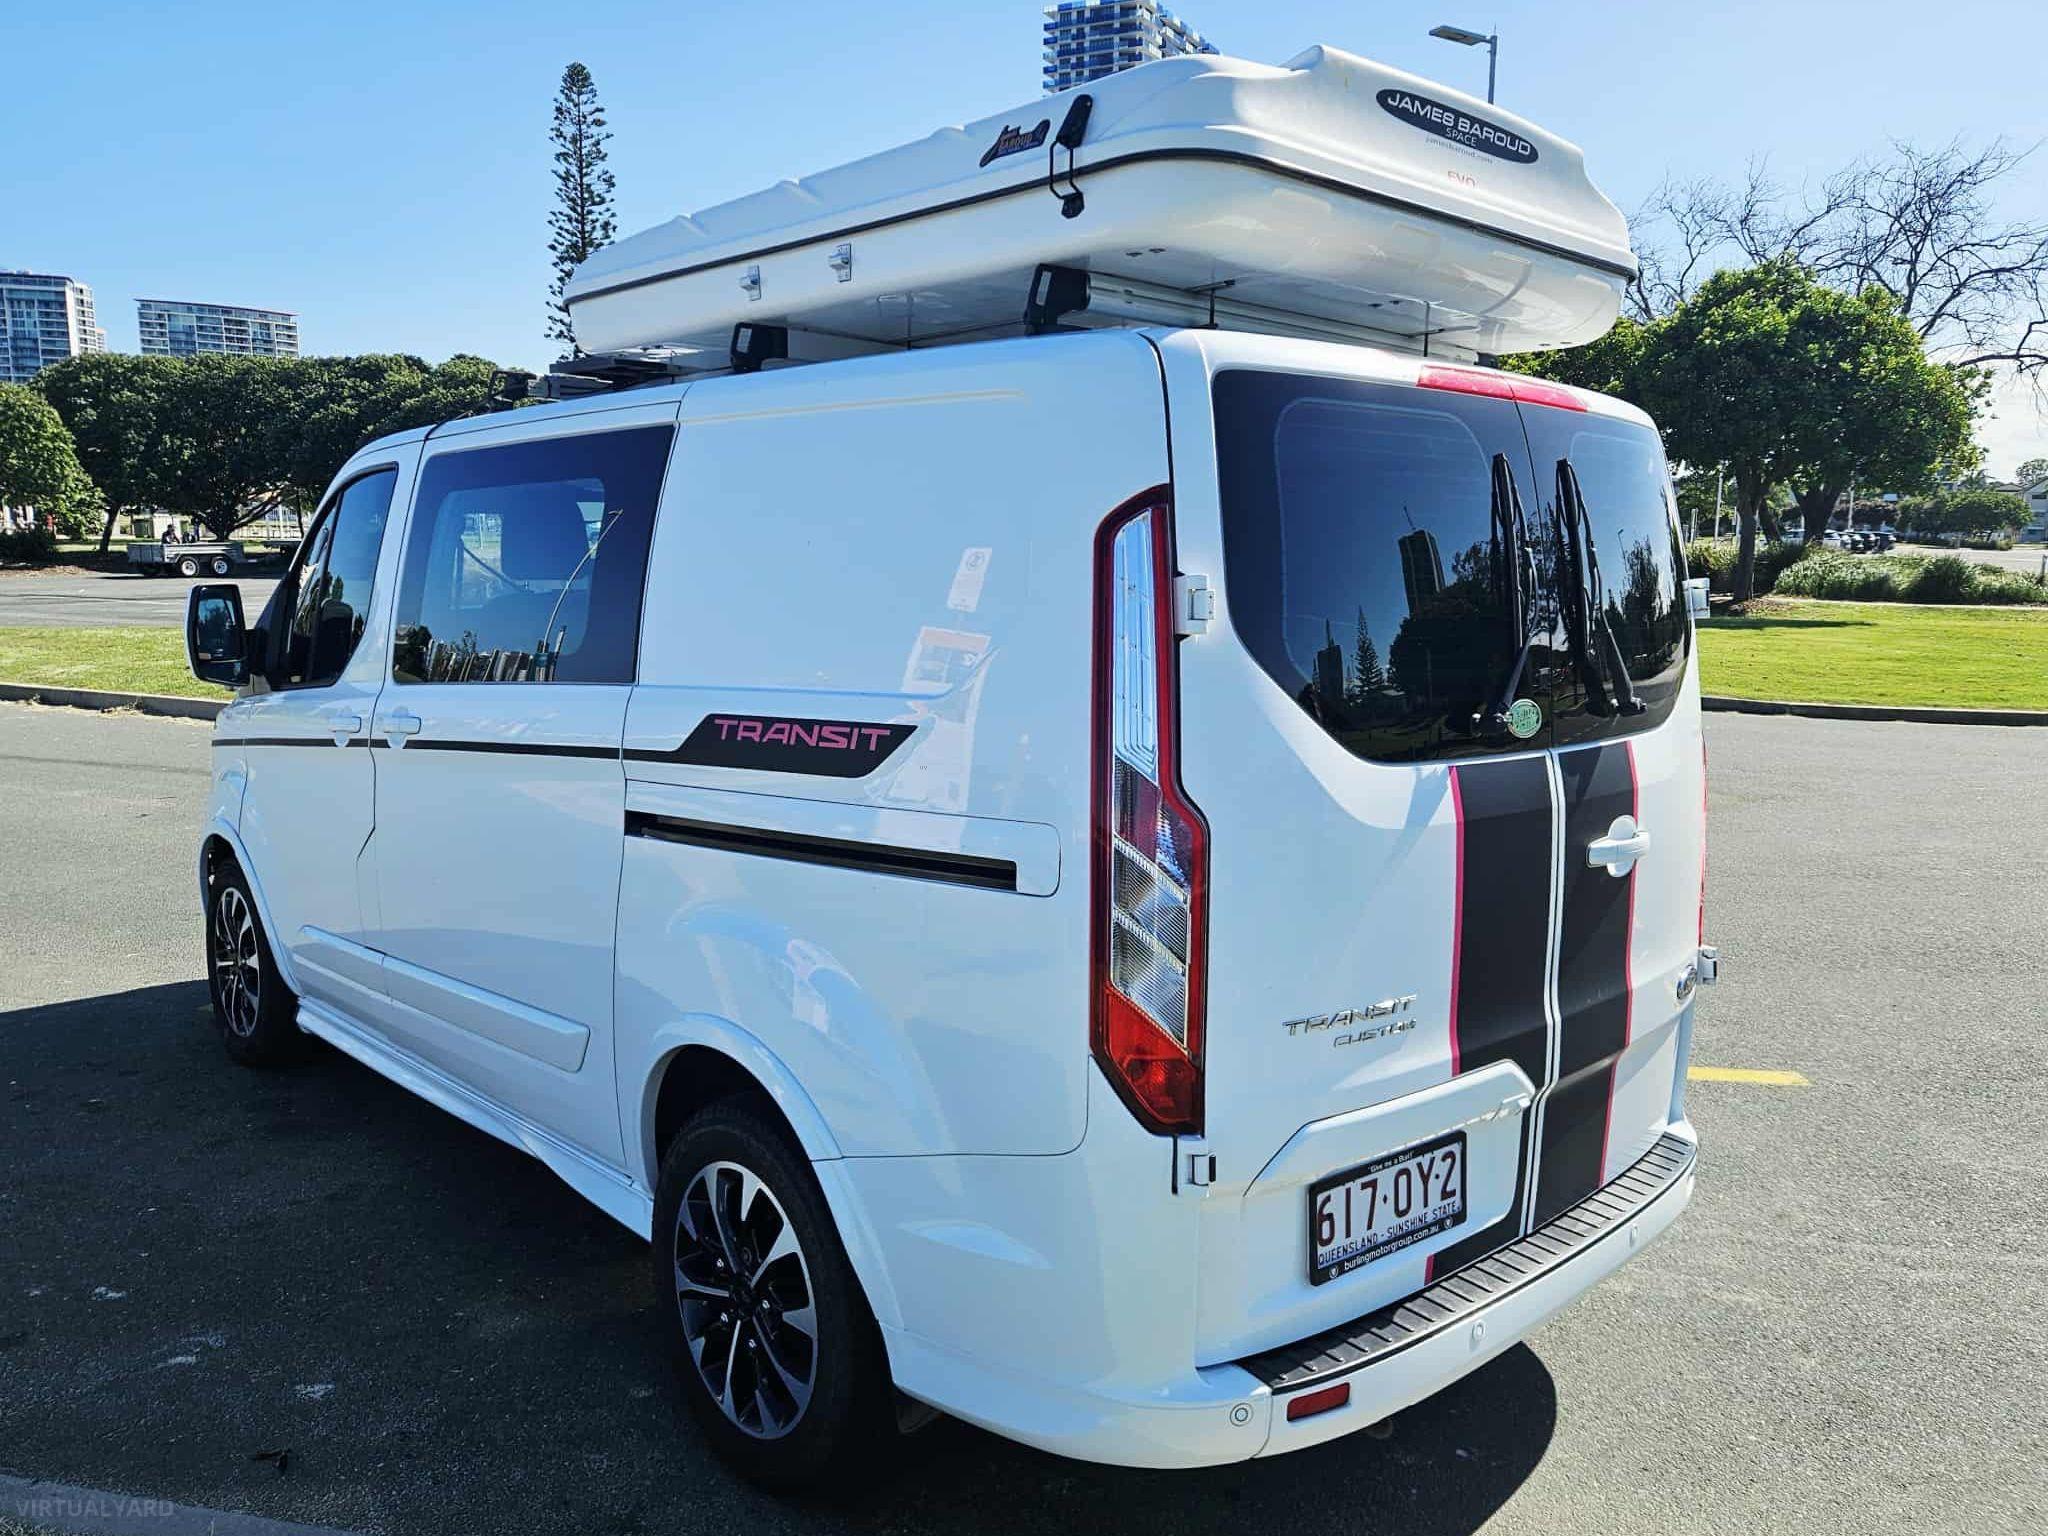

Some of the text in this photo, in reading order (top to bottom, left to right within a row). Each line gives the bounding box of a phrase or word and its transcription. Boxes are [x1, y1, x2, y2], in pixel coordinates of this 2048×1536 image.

[1387, 93, 1531, 155] JAMES BAROUD
[1446, 127, 1477, 147] SPACE
[714, 718, 891, 751] TRANSIT
[1282, 994, 1417, 1036] TRANSIT
[1387, 1212, 1429, 1239] SUNSHINE
[1344, 1225, 1439, 1270] burlingmotorgroup.com.au
